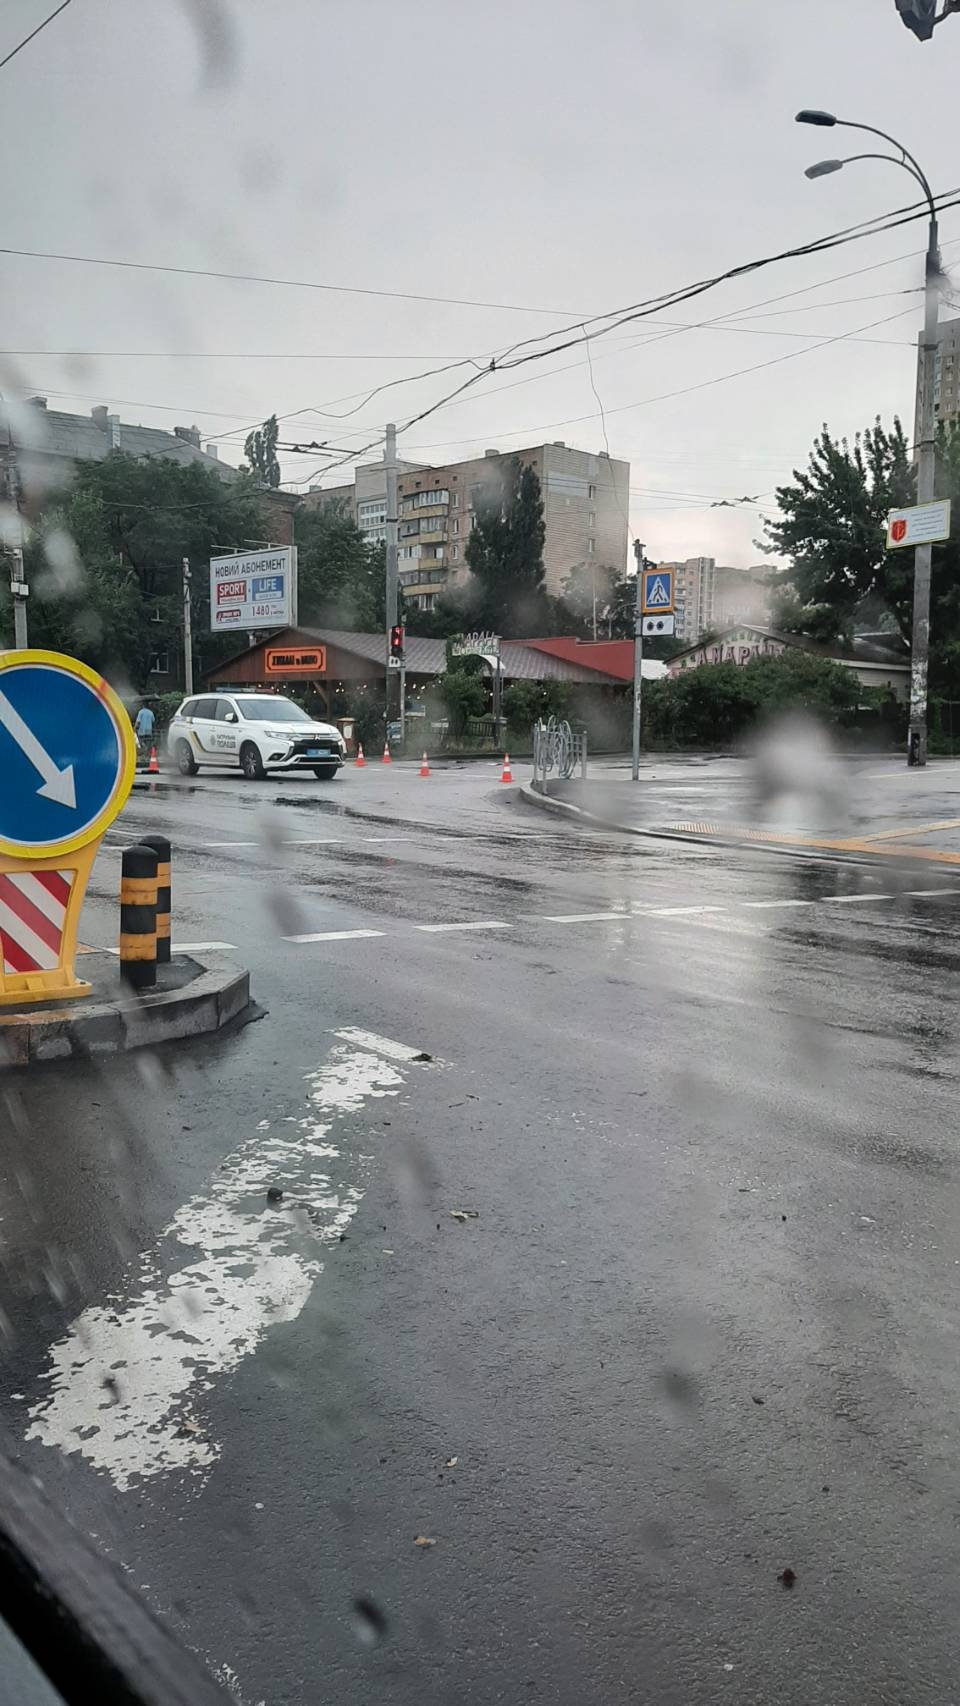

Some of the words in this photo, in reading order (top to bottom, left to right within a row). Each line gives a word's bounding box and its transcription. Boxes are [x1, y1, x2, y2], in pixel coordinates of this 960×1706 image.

[215, 561, 240, 577] НОВИЙ
[241, 558, 286, 574] АБОНЕМЕНТ
[219, 582, 245, 596] SPORT
[259, 578, 277, 592] LIFE
